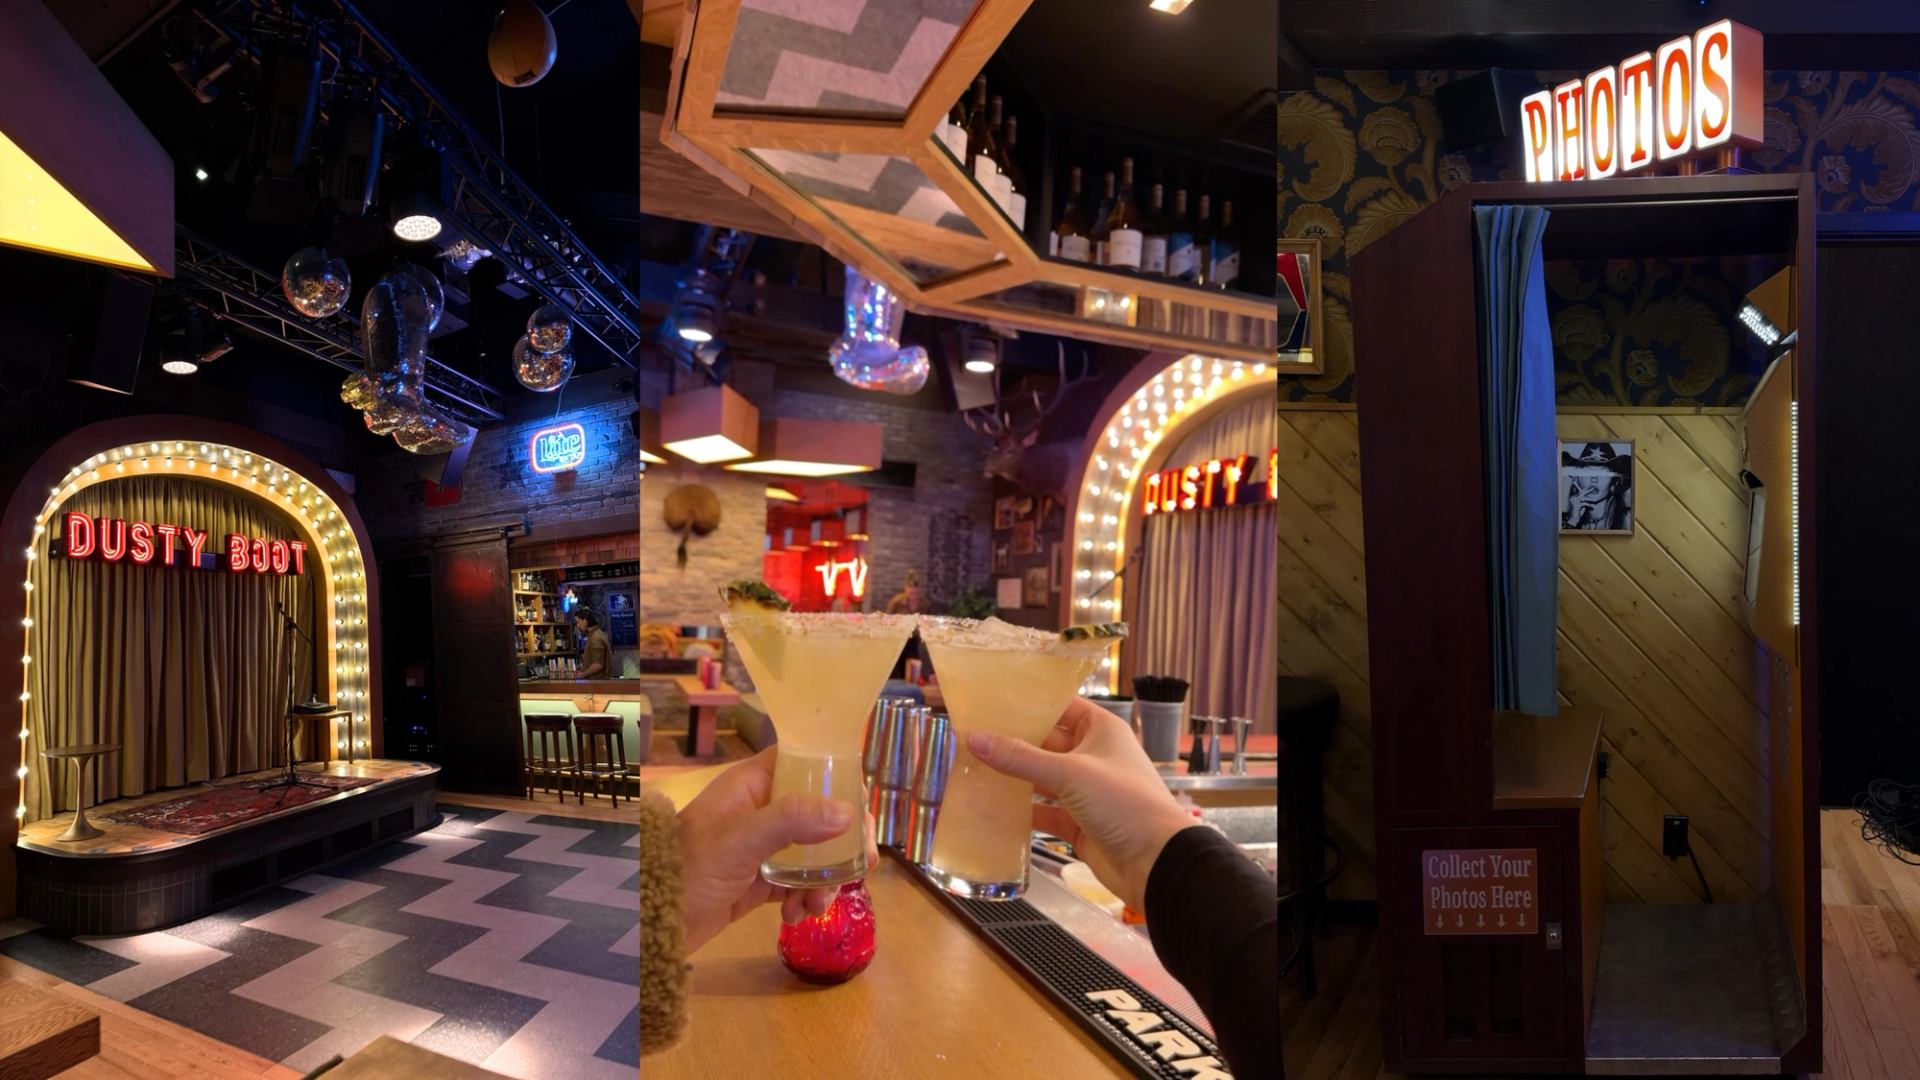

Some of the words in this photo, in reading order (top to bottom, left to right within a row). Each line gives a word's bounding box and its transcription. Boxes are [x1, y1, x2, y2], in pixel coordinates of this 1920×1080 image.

[1525, 31, 1730, 182] PHOTOS
[1142, 452, 1250, 515] DUSTY
[66, 511, 207, 568] DUSTY
[227, 532, 307, 576] BOOT
[1428, 854, 1486, 879] Collect
[1489, 854, 1532, 878] Your
[1430, 885, 1487, 909] Photos
[1490, 885, 1532, 908] Here
[1085, 988, 1238, 1080] PARK
